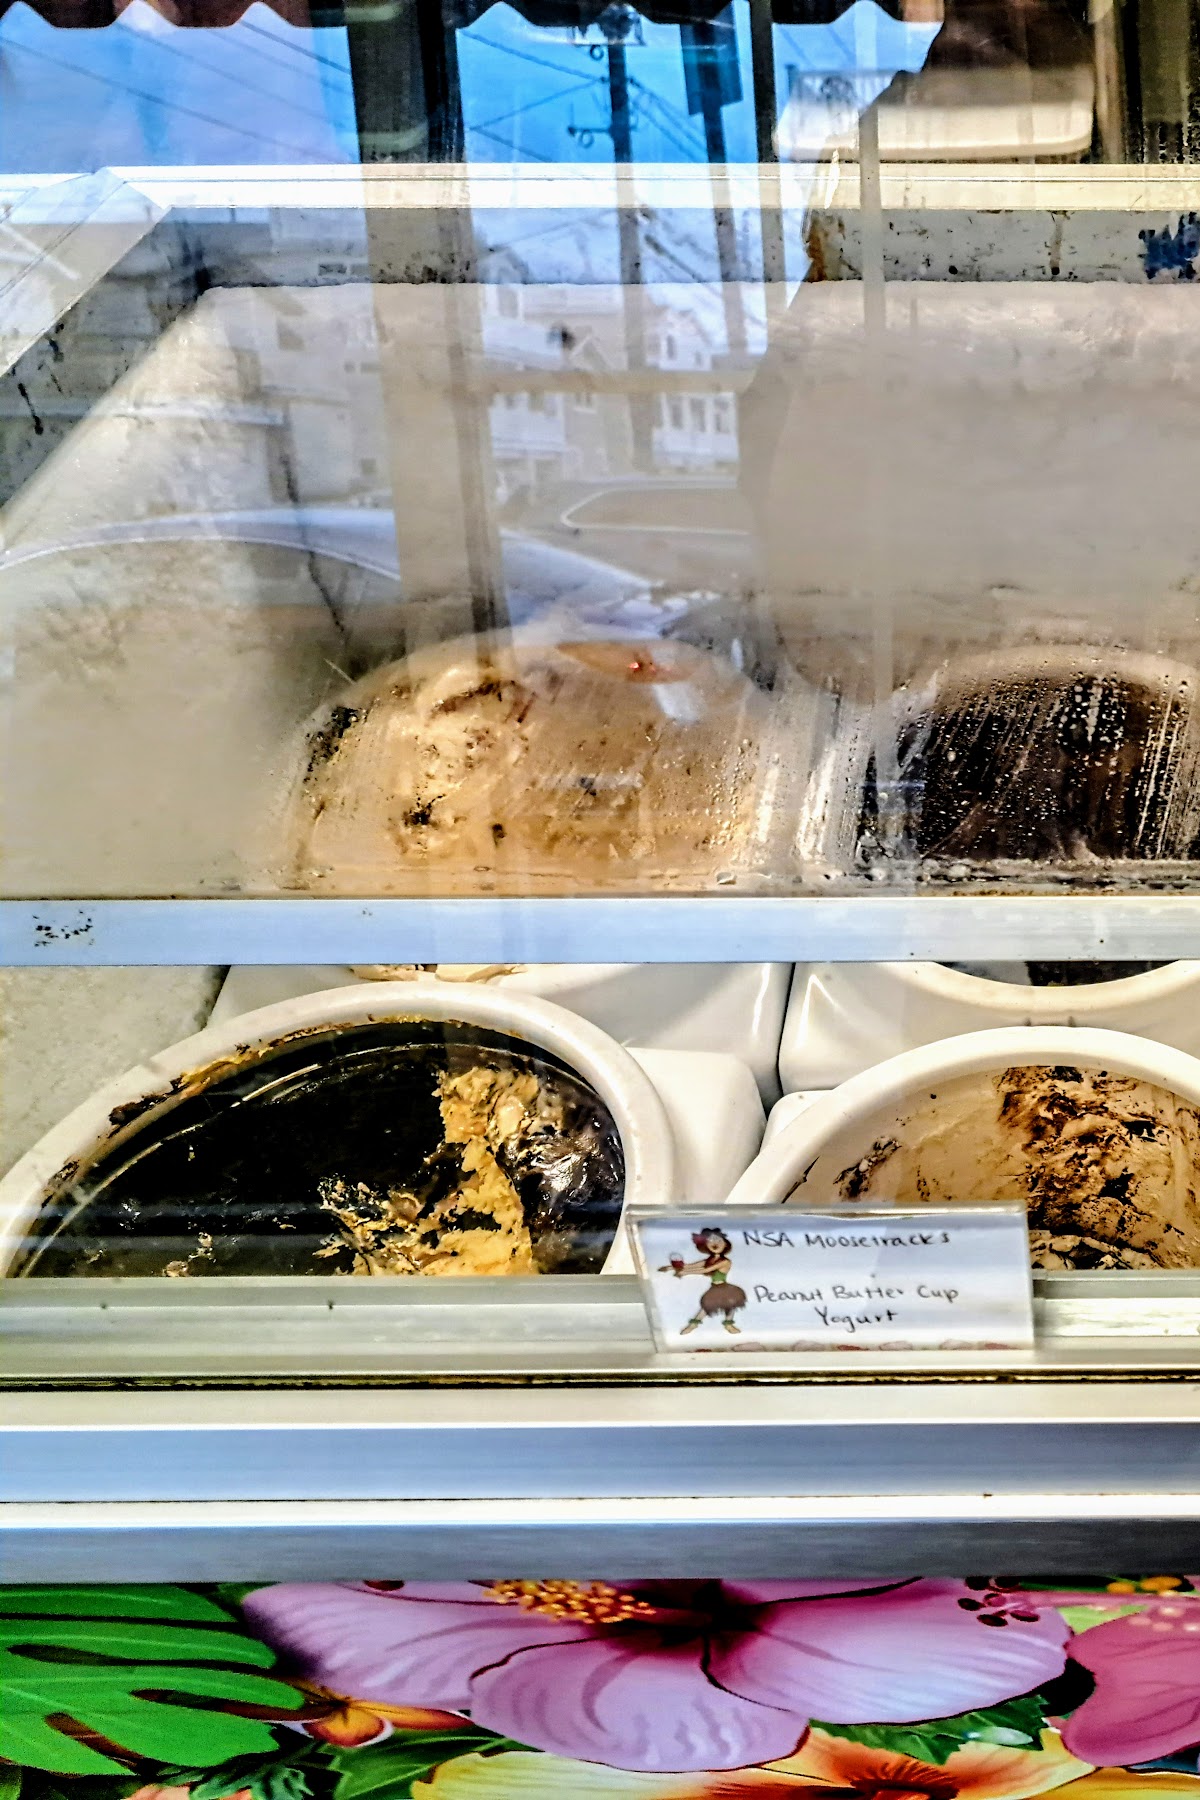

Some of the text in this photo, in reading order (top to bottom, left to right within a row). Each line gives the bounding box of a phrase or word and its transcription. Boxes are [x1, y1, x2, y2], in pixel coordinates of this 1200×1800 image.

[743, 1230, 951, 1249] NSA Moosetracks
[754, 1284, 960, 1304] Peanut Butter Cup
[814, 1306, 898, 1333] Yogurt
